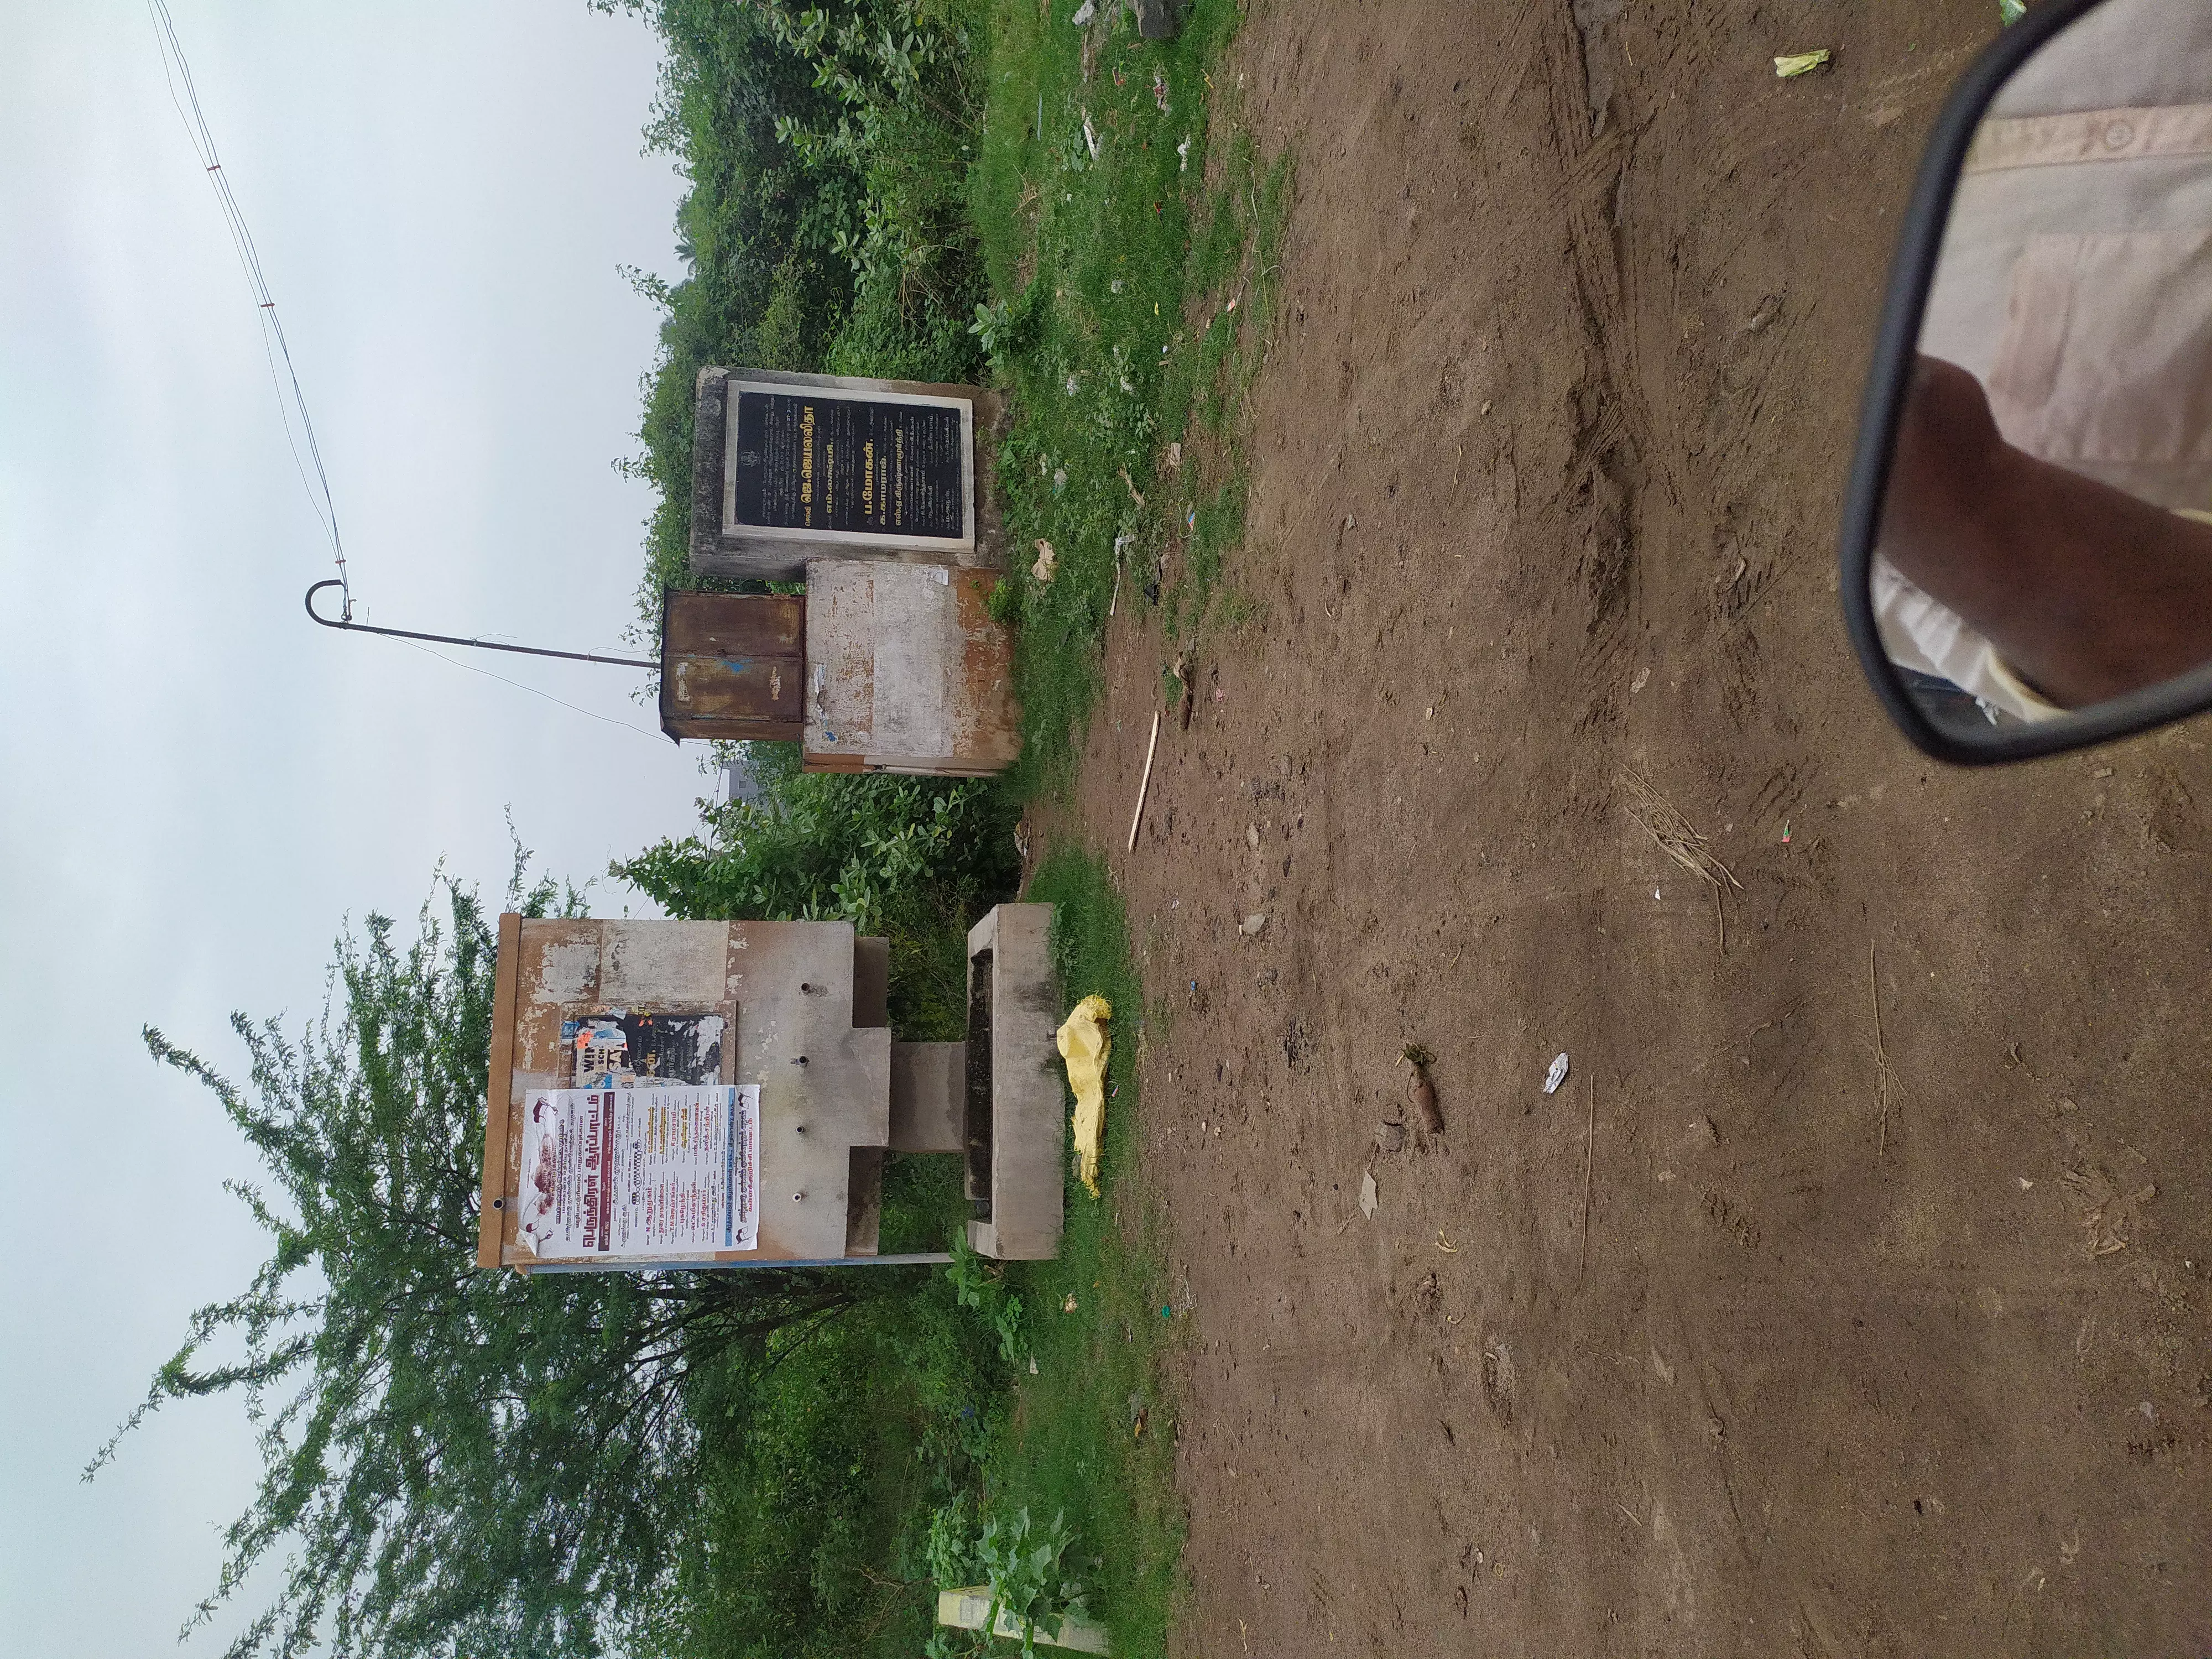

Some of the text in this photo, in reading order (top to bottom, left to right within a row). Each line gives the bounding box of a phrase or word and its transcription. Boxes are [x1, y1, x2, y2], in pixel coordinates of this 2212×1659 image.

[799, 405, 815, 503] ஜெ.ஜெயலலிதா
[862, 439, 874, 514] ப.மோகன்.
[894, 429, 904, 525] எஸ்.ஏ.கிருஷ்ணமூர்த்தி
[583, 1094, 600, 1248] பெருந்திரள் ஆர்ப்பாட்டம்
